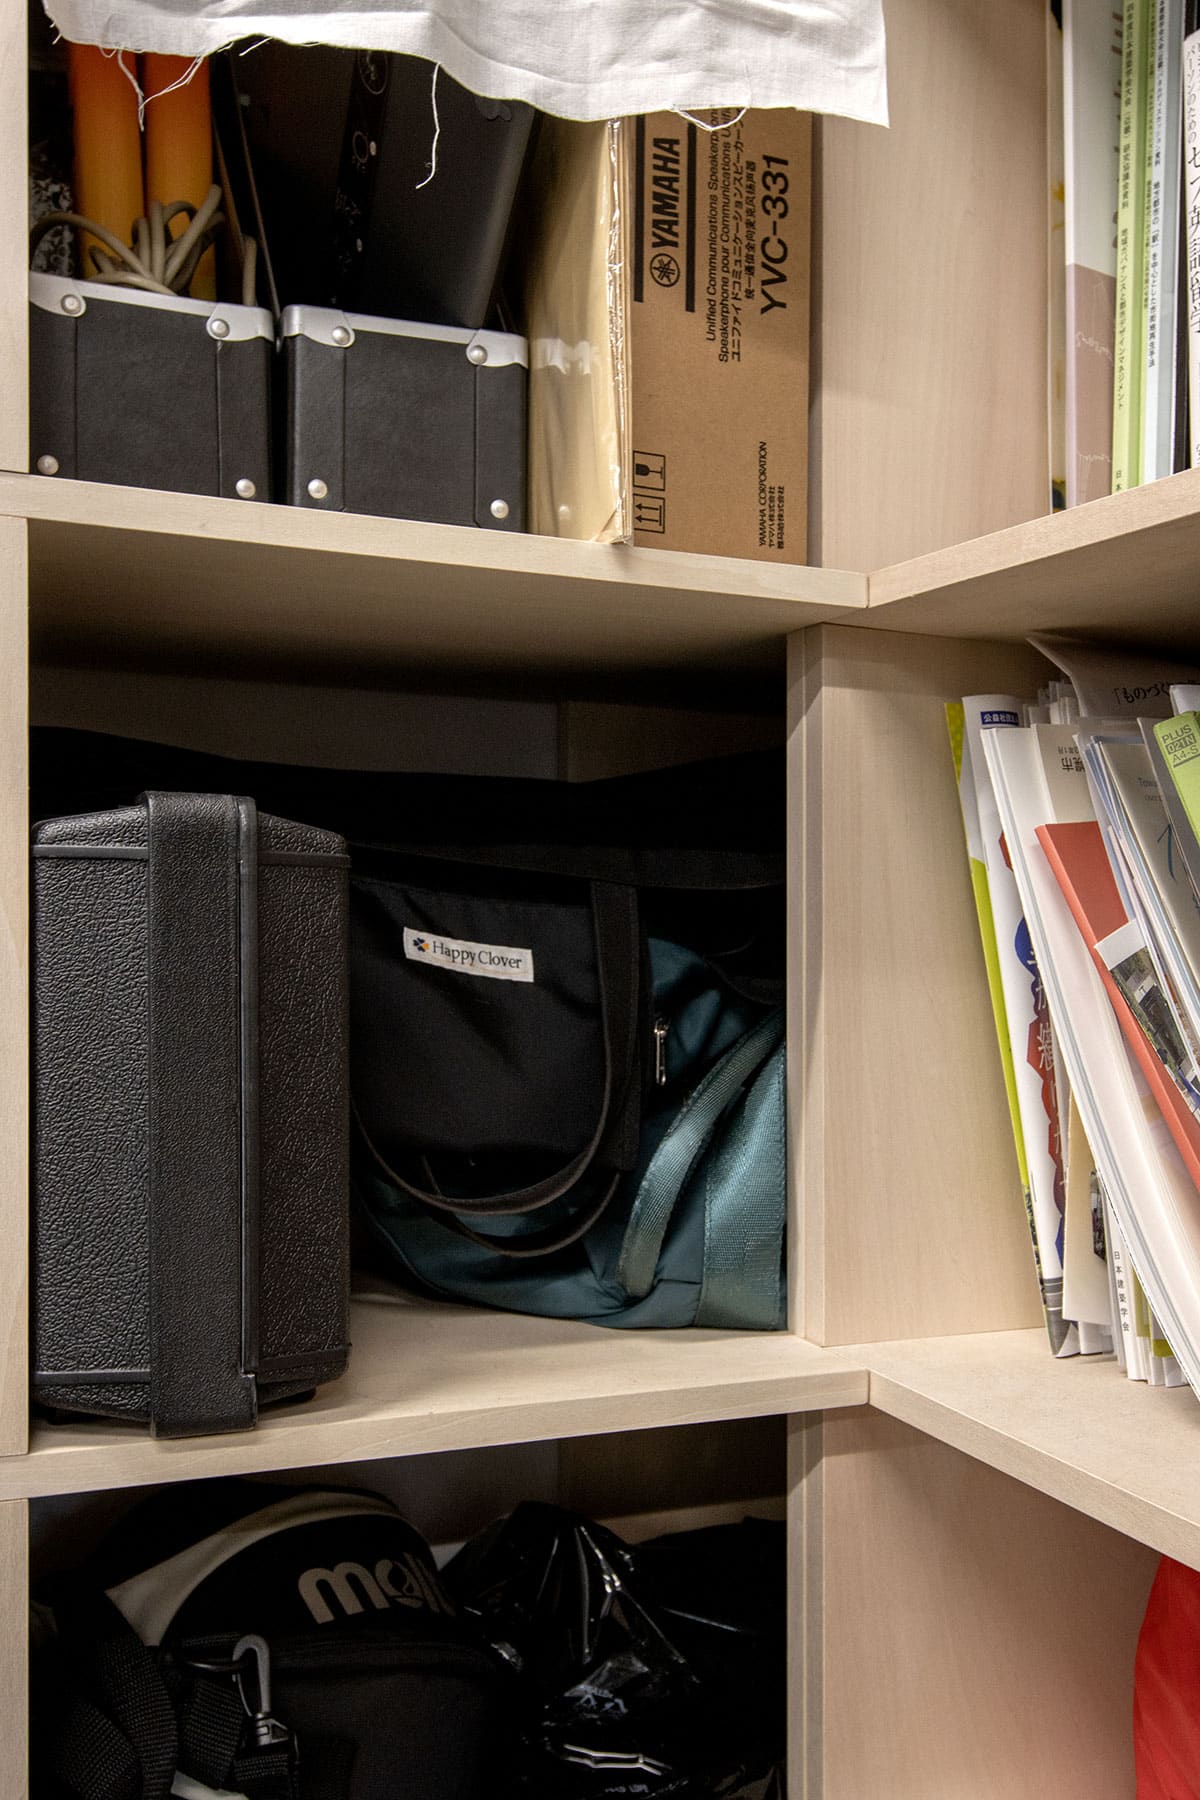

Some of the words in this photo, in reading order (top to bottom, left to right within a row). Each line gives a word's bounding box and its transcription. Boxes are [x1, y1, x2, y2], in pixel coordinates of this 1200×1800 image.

[652, 138, 680, 249] YAMAHA
[720, 142, 731, 243] Communications
[707, 194, 718, 295] Communications
[721, 246, 731, 274] pour
[760, 153, 789, 316] YVC-331
[707, 299, 717, 342] Unified
[719, 277, 730, 363] Speakerphone
[758, 441, 767, 506] CORPORATION
[758, 508, 767, 547] YAMAHA
[1162, 724, 1193, 744] PLUS
[1172, 745, 1199, 763] A4-S
[432, 940, 477, 966] Happy
[478, 950, 523, 969] Clover
[1113, 1250, 1130, 1332] 日本建築学会
